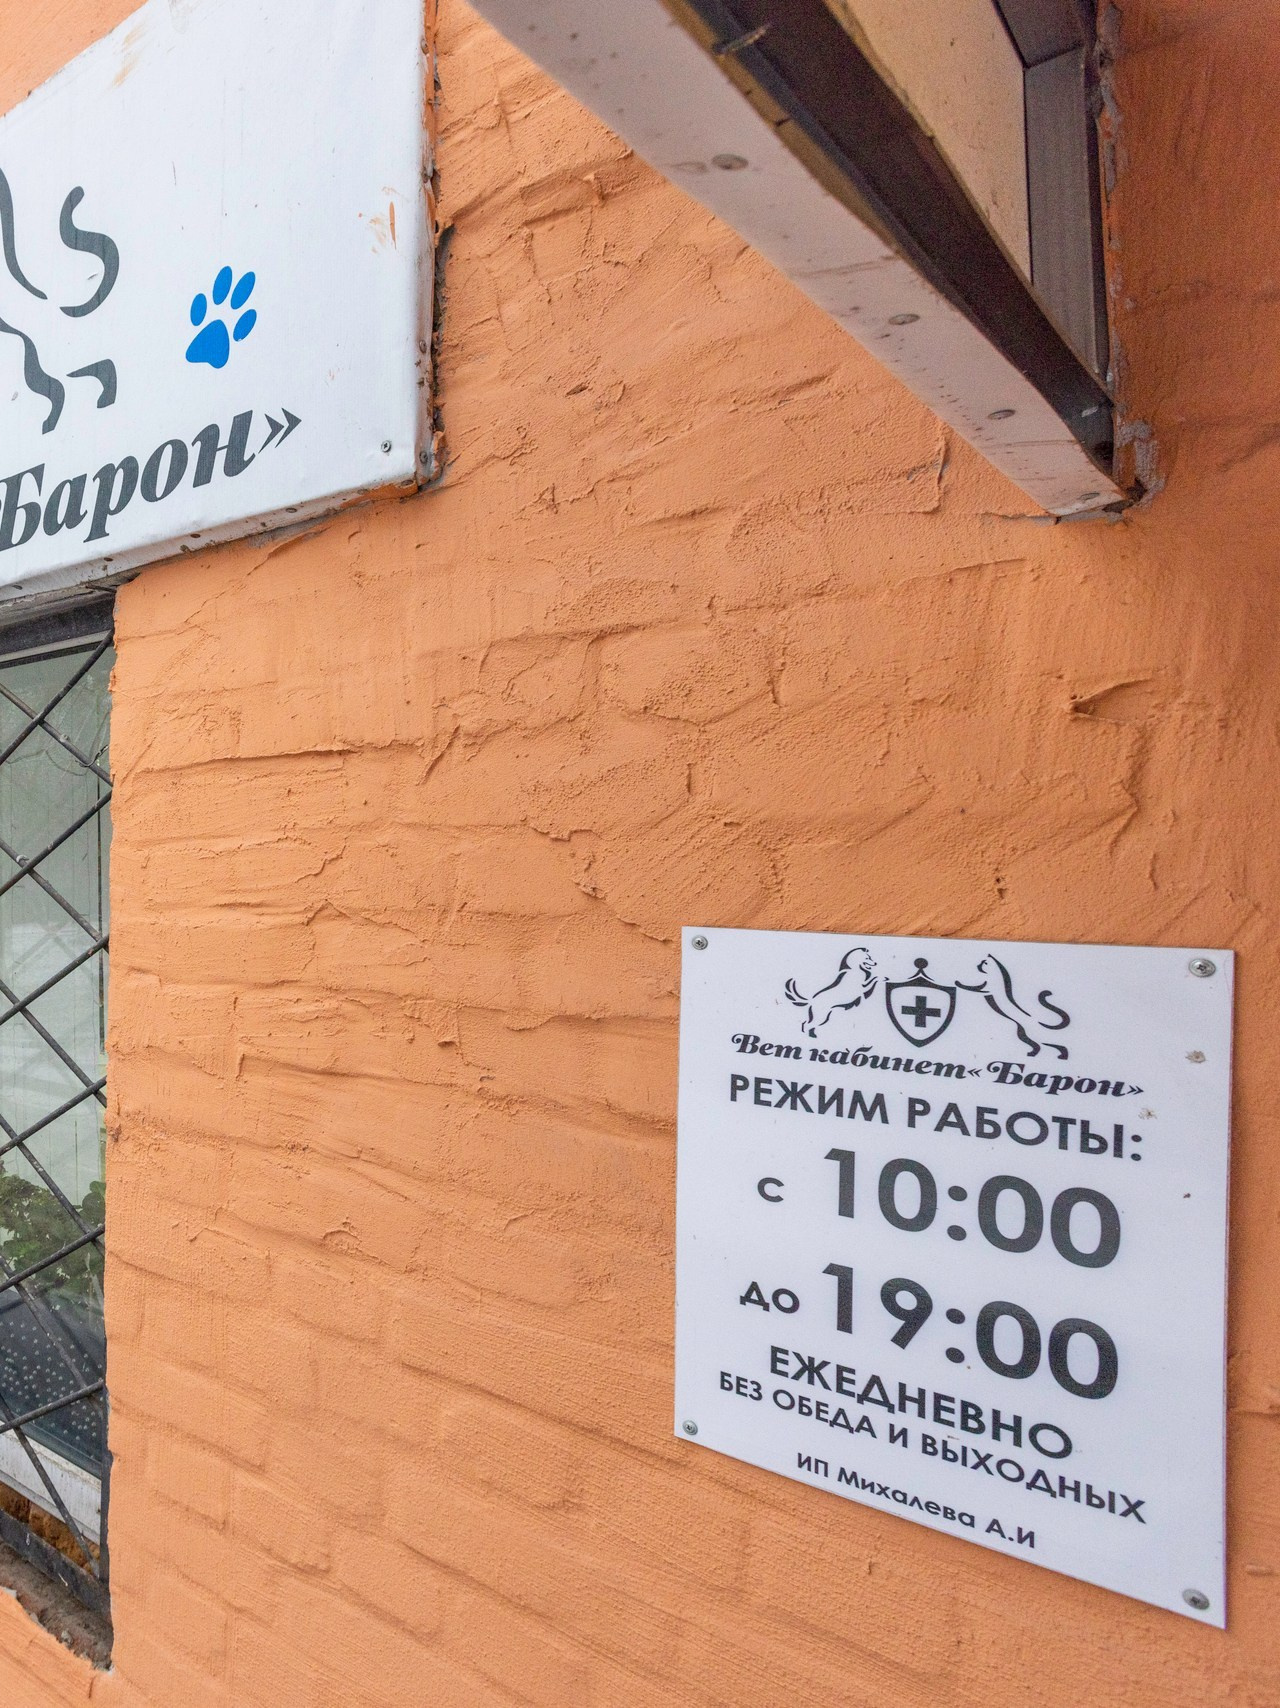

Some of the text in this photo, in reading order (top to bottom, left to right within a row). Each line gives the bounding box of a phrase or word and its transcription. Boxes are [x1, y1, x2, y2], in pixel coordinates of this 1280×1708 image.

[731, 1033, 803, 1061] Вет
[730, 1073, 1143, 1162] РЕЖИМ РАБОТЫ:
[823, 1147, 1122, 1269] 10:00
[821, 1262, 1119, 1400] 19:00
[719, 1370, 1147, 1525] БЕЗ ОБЕДА И ВЫХОДНЫХ
[770, 1345, 1073, 1460] ЕЖЕДНЕВНО
[797, 1452, 1036, 1549] ИП Михалева А.И
